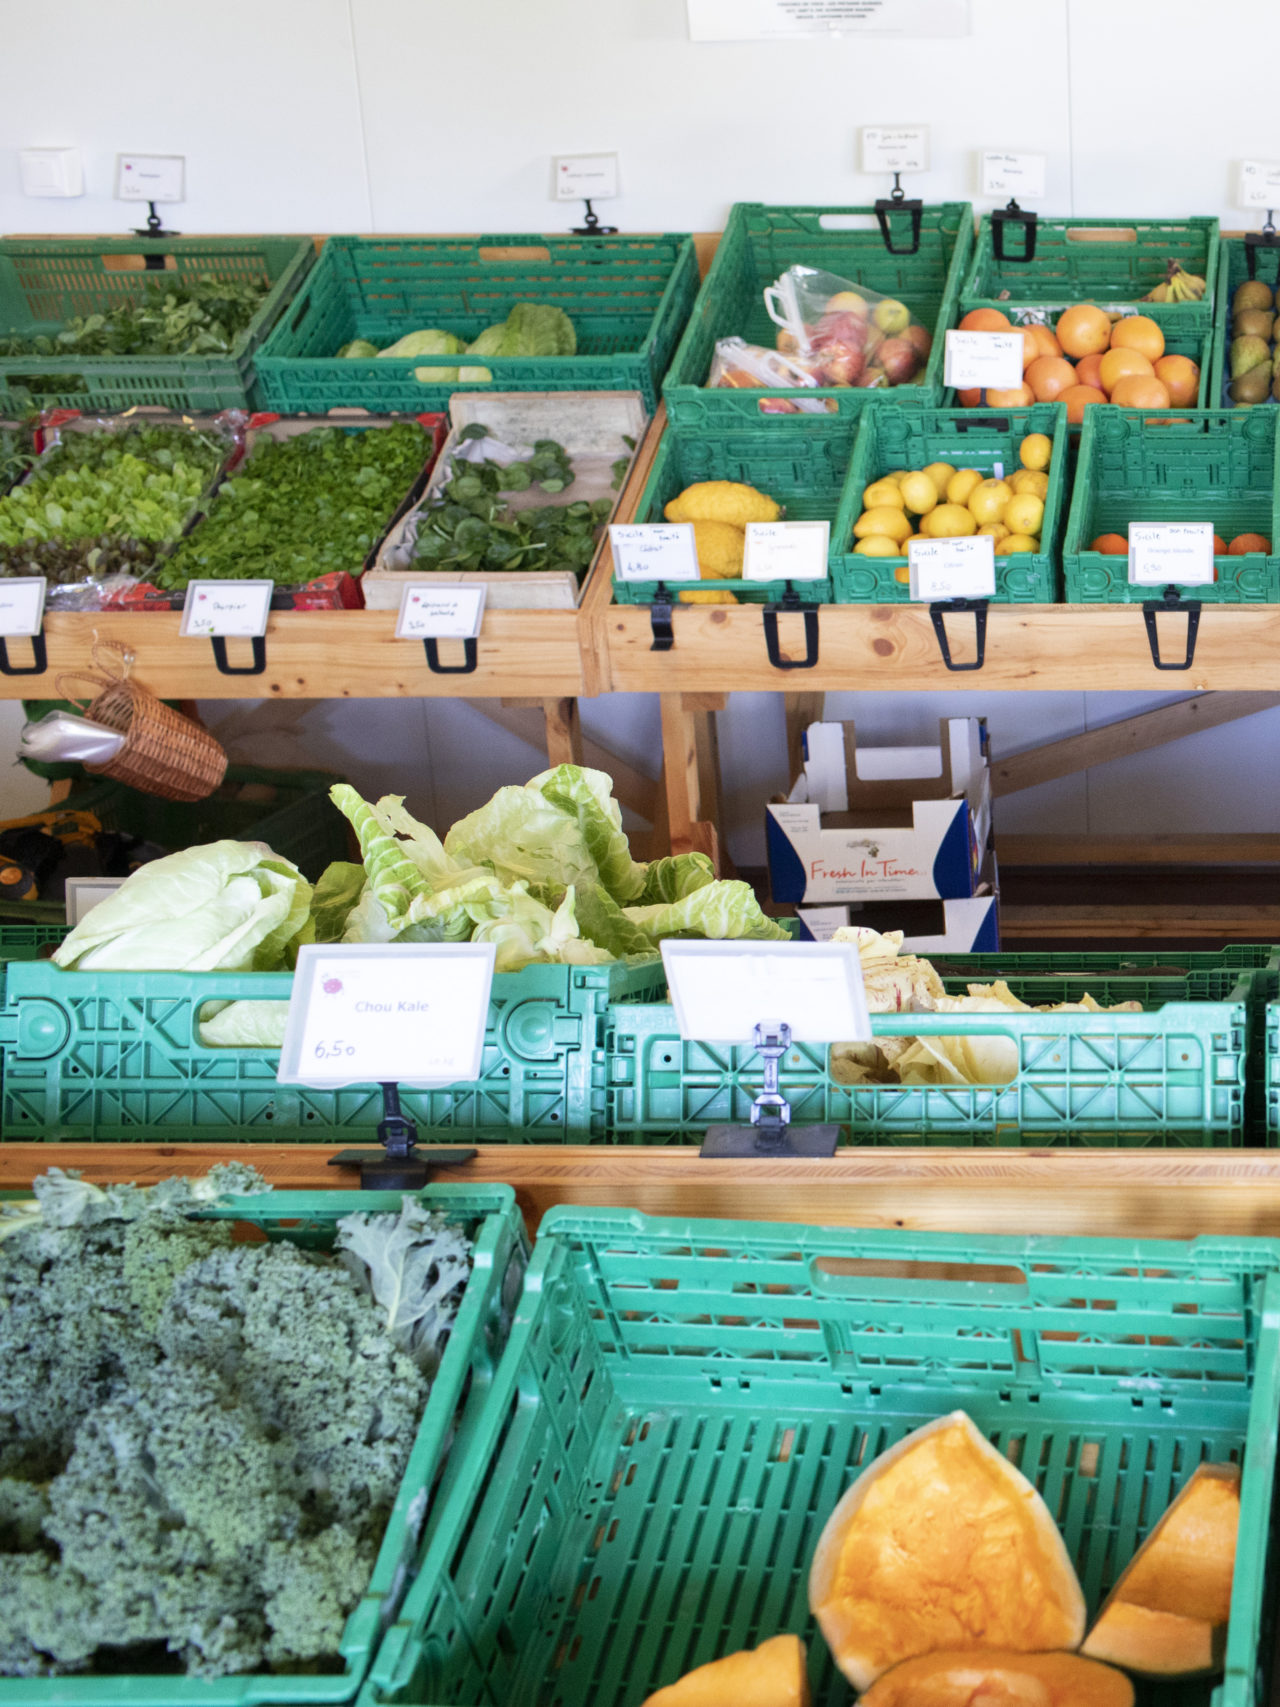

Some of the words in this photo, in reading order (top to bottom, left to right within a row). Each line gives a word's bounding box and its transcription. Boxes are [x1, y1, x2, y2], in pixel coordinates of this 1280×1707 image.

[1134, 531, 1160, 541] Sicile
[810, 859, 857, 880] Fresh
[860, 859, 878, 878] In
[354, 1000, 393, 1013] Chou
[396, 1000, 430, 1012] Kale
[314, 1040, 356, 1059] 6,50
